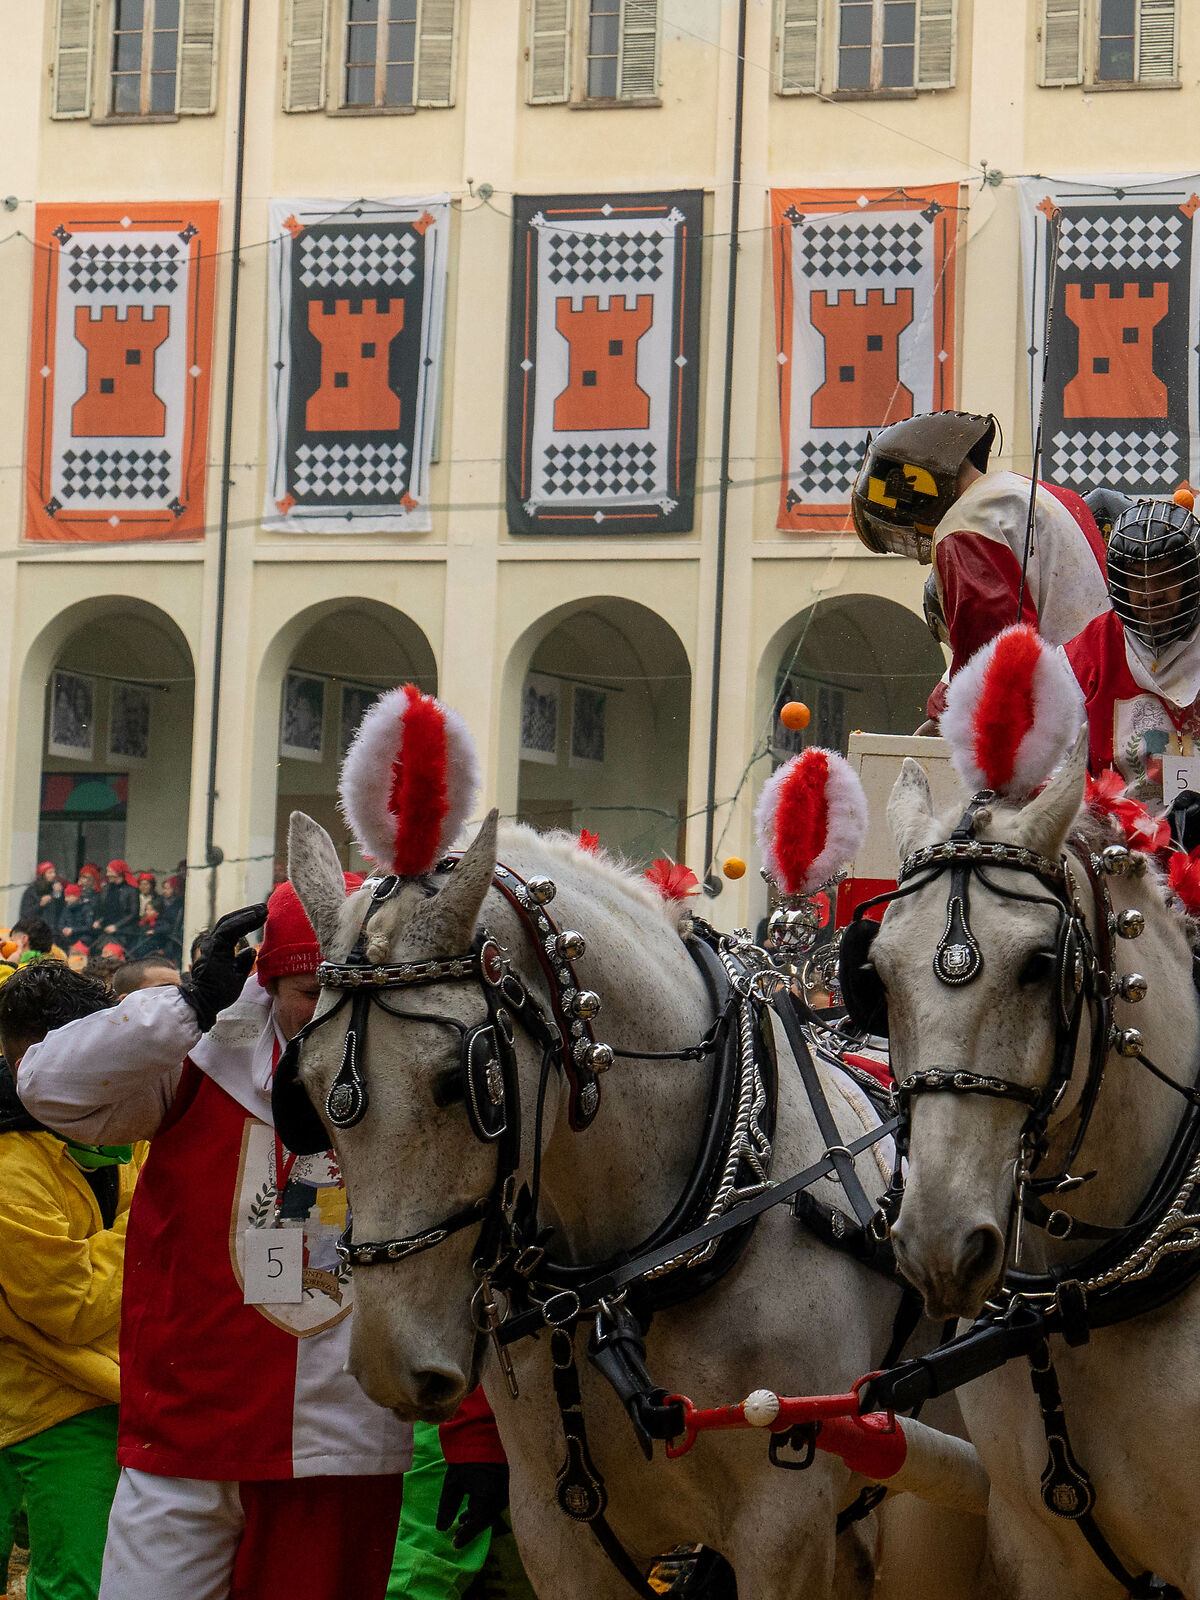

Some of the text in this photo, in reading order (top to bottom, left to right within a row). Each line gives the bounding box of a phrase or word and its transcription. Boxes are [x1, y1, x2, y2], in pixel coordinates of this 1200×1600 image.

[1176, 769, 1189, 790] 5
[266, 1246, 284, 1279] 5
[302, 1269, 324, 1279] ONTI
[303, 1279, 337, 1293] ORENZO
